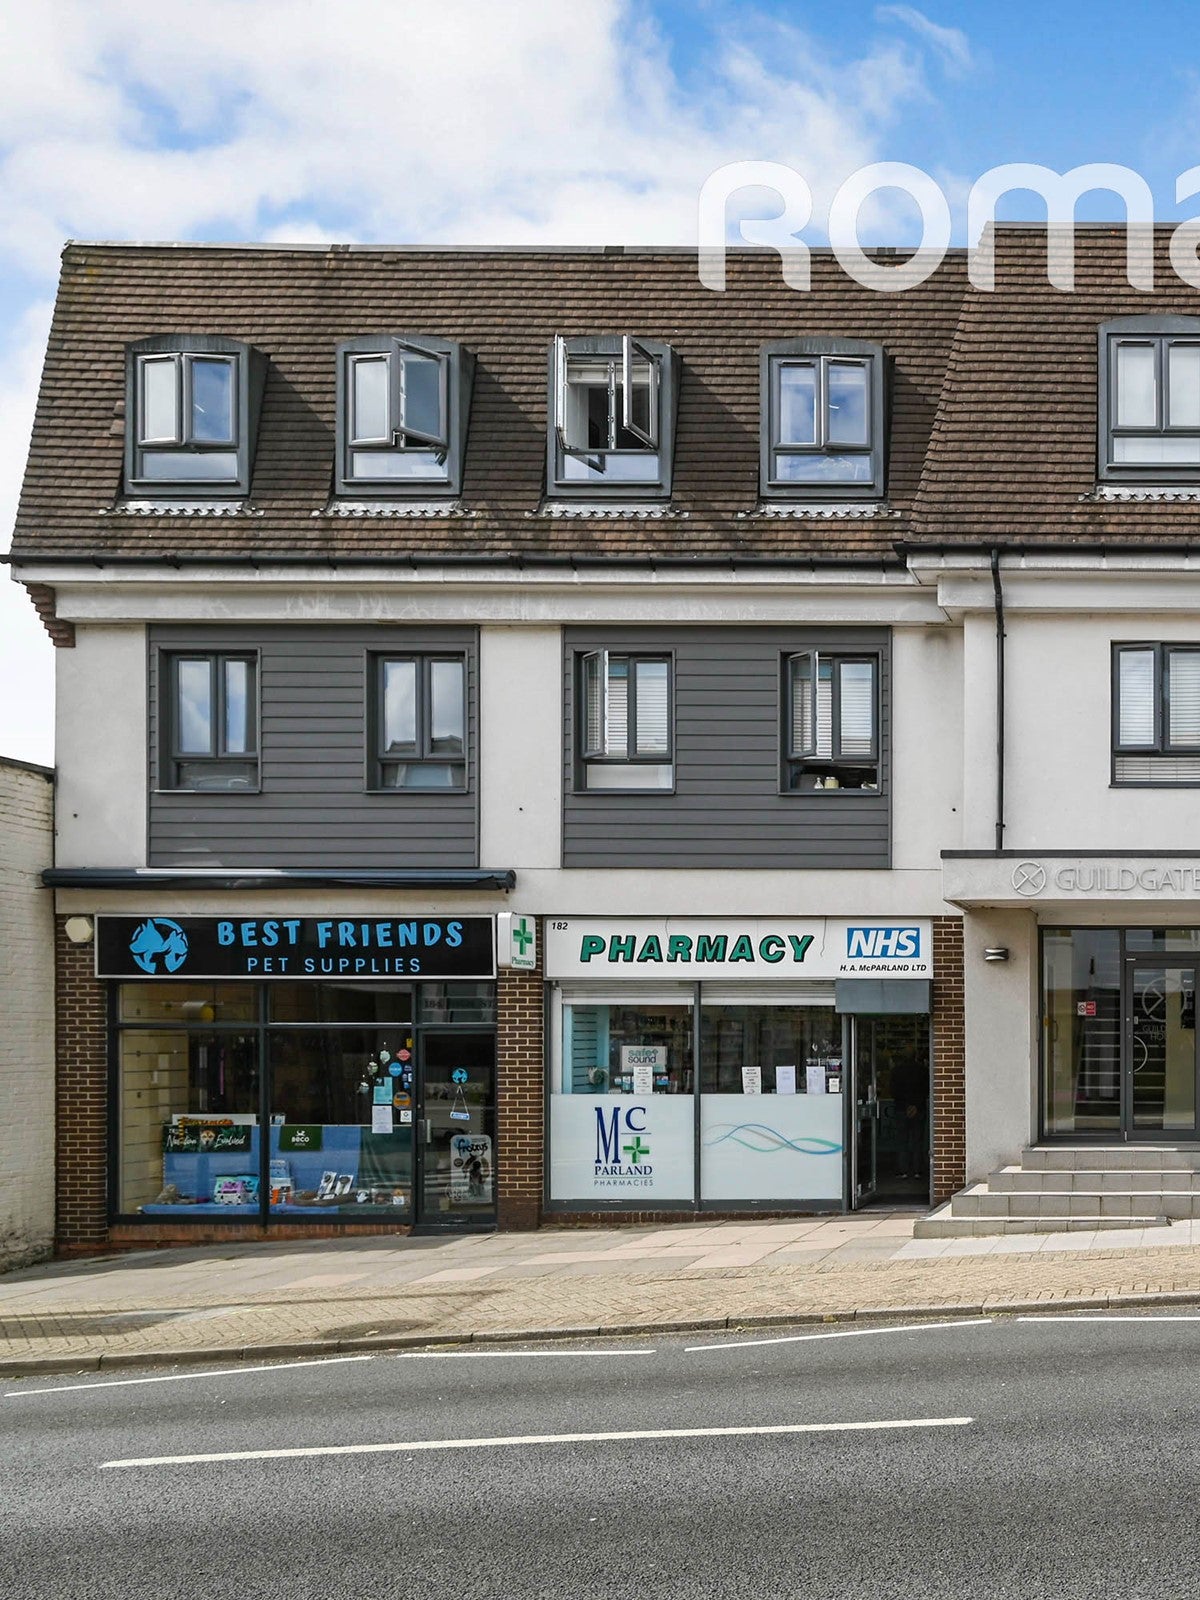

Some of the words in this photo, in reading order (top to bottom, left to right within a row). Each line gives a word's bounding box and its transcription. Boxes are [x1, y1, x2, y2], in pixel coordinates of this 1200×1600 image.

[551, 921, 568, 931] 182
[217, 920, 300, 947] BEST
[317, 921, 463, 948] FRIENDS
[848, 929, 918, 956] NHS
[580, 935, 814, 962] PHARMACY
[247, 958, 288, 972] PET
[304, 958, 420, 972] SUPPLIES
[511, 956, 534, 967] Pharmacy
[840, 964, 848, 972] H.
[850, 964, 857, 972] A.
[858, 964, 909, 972] McPARLAND
[911, 964, 926, 972] LTD
[595, 1165, 653, 1175] PARLAND
[594, 1179, 653, 1187] PHARMACIES
